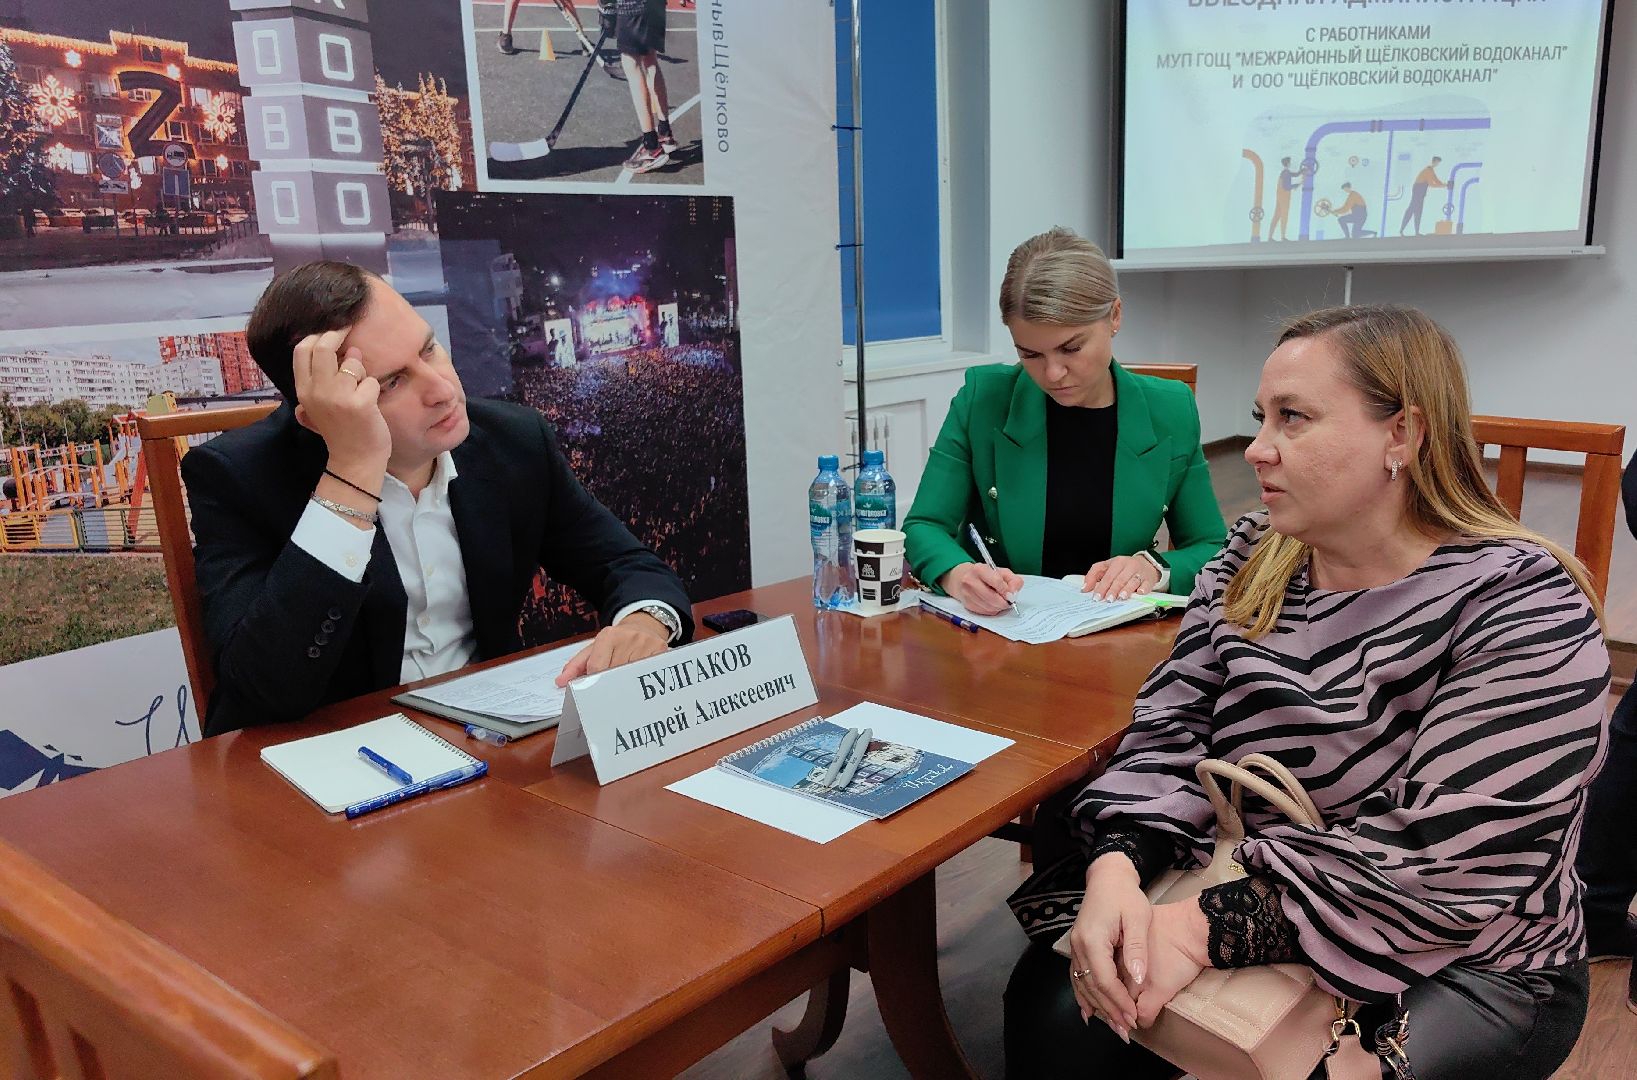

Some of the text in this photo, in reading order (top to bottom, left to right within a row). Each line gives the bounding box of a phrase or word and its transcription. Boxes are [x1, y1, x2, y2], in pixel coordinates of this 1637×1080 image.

[1305, 25, 1432, 43] С РАБОТНИКАМИ
[1156, 43, 1568, 70] МУП ГОЩ "МЕЖРАЙОННЫЙ ЩЁЛКОВСКИЙ ВОДОКАНАЛ"
[1232, 66, 1499, 90] И ООО "ЩЁЛКОВСКИЙ ВОДОКАНАЛ"
[636, 643, 753, 701] БУЛГАКОВ
[613, 673, 798, 756] Андрей Алексеевич
